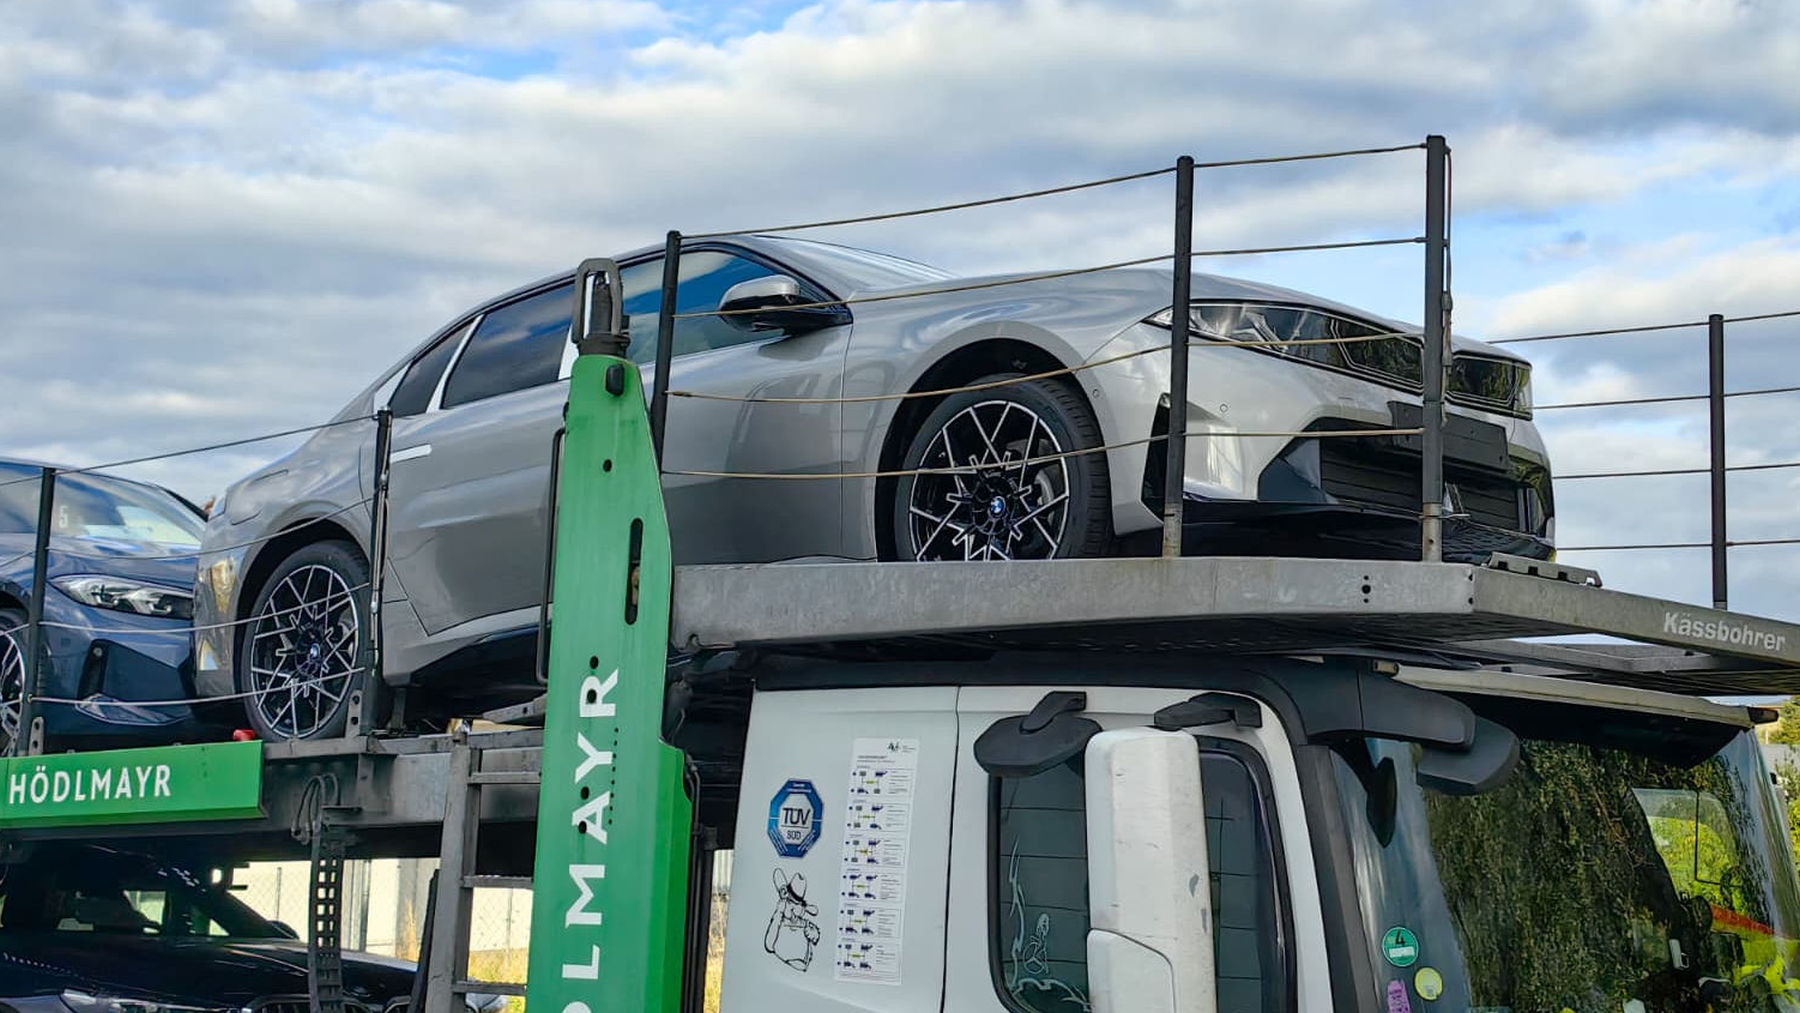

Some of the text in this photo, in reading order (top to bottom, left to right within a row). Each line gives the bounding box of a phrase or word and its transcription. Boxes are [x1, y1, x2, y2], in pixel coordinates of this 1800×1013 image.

[1663, 611, 1786, 651] Kässbohrer
[9, 765, 171, 805] HÖDLMAYR
[1395, 930, 1406, 948] 4
